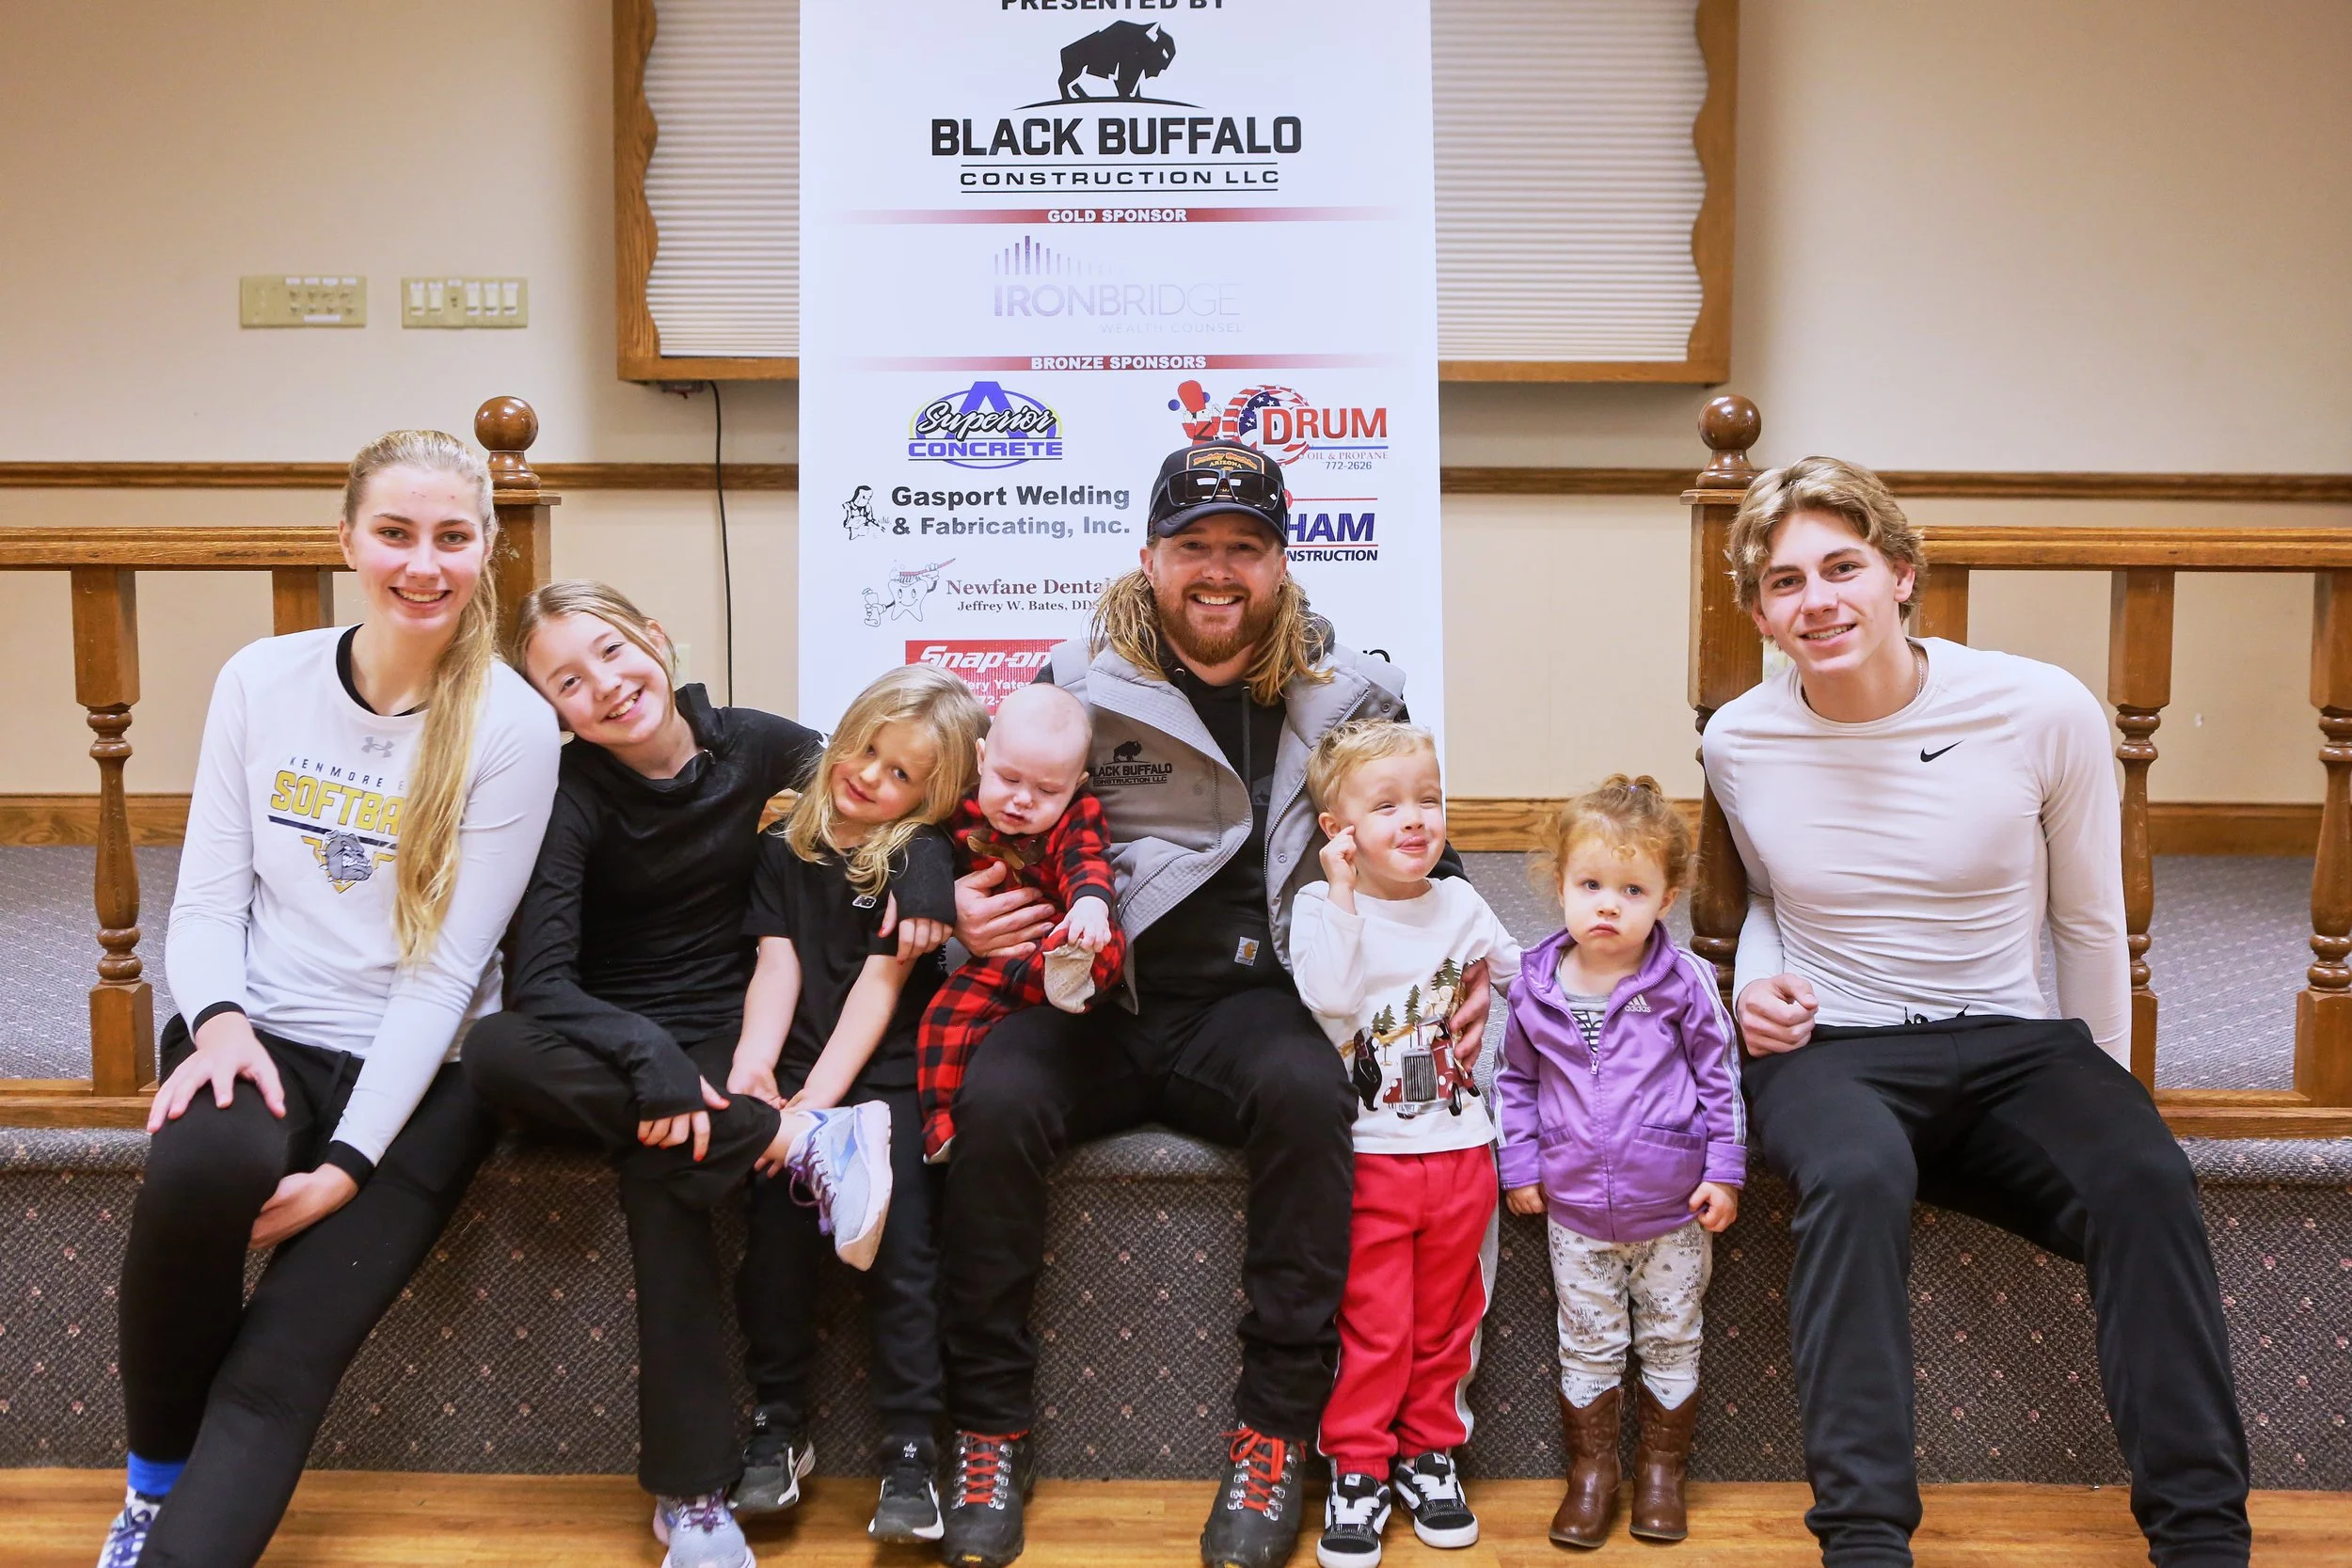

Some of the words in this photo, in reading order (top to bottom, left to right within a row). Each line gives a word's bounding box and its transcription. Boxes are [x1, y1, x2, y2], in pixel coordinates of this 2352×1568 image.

[931, 118, 1084, 155] BLACK
[1098, 116, 1301, 155] BUFFALO
[960, 171, 1212, 185] CONSTRUCTION
[1225, 170, 1279, 183] LLC
[1047, 210, 1097, 223] GOLD
[1101, 209, 1187, 222] SPONSOR
[993, 284, 1241, 317] IRONBRIDGE
[1101, 323, 1162, 334] WEALTH
[1170, 323, 1243, 333] COUNSEL
[1031, 356, 1104, 370] BRONZE
[1109, 356, 1206, 369] SPONSORS
[916, 400, 1057, 442] Superior
[1263, 407, 1388, 445] DRUM
[908, 442, 1063, 457] CONCRETE
[1339, 451, 1389, 460] PROPANE
[1209, 460, 1242, 469] ARIZONA
[1326, 461, 1373, 470] 772-2626
[891, 486, 1008, 511] Gasport
[1016, 485, 1130, 510] Welding
[892, 517, 911, 535] &
[920, 516, 1073, 539] Fabricating,
[1083, 516, 1130, 534] Inc.
[1287, 513, 1375, 542] HAM
[1287, 549, 1378, 562] NSTRUCTION
[946, 578, 1037, 594] Newfane
[957, 600, 1004, 612] Jeffrey
[1007, 601, 1025, 610] W.
[1028, 600, 1068, 611] Bates,
[920, 645, 1052, 673] Snap-on
[290, 756, 384, 788] KENMORE
[1122, 763, 1173, 776] BUFFALO
[270, 769, 405, 836] SOFTBA
[1624, 1005, 1652, 1013] adidas
